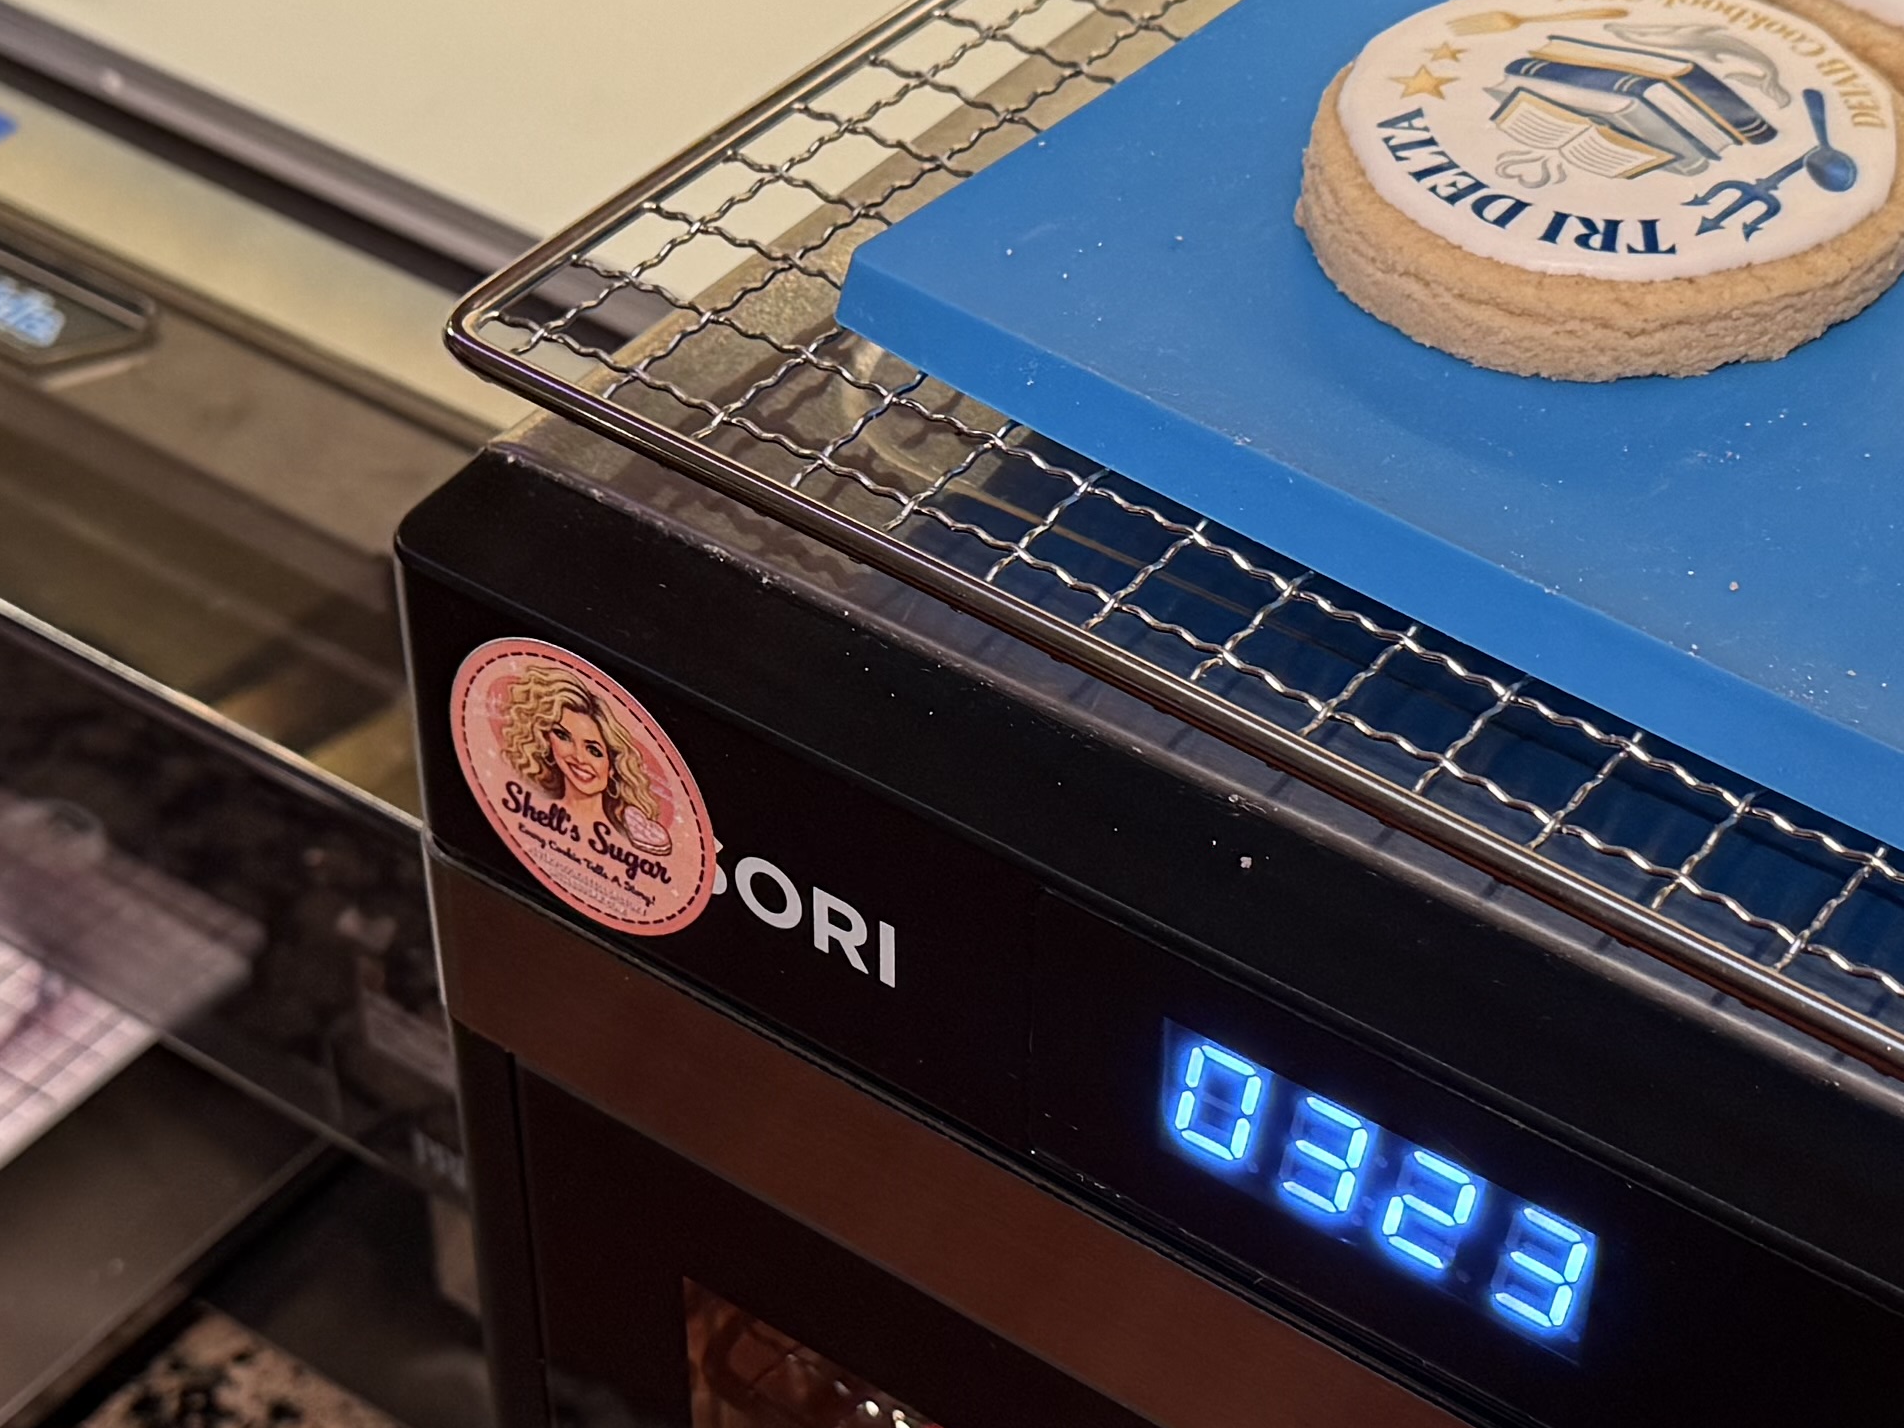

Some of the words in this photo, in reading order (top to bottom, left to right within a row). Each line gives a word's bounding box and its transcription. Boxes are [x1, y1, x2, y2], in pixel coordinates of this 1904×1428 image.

[1815, 57, 1887, 130] DEIAB
[1376, 107, 1535, 230] DELTA
[1537, 209, 1678, 256] TRI
[501, 780, 581, 842] Shell's
[588, 821, 672, 884] Sugar
[611, 875, 622, 888] A
[713, 835, 896, 988] ORI
[1173, 1044, 1589, 1329] 0323
